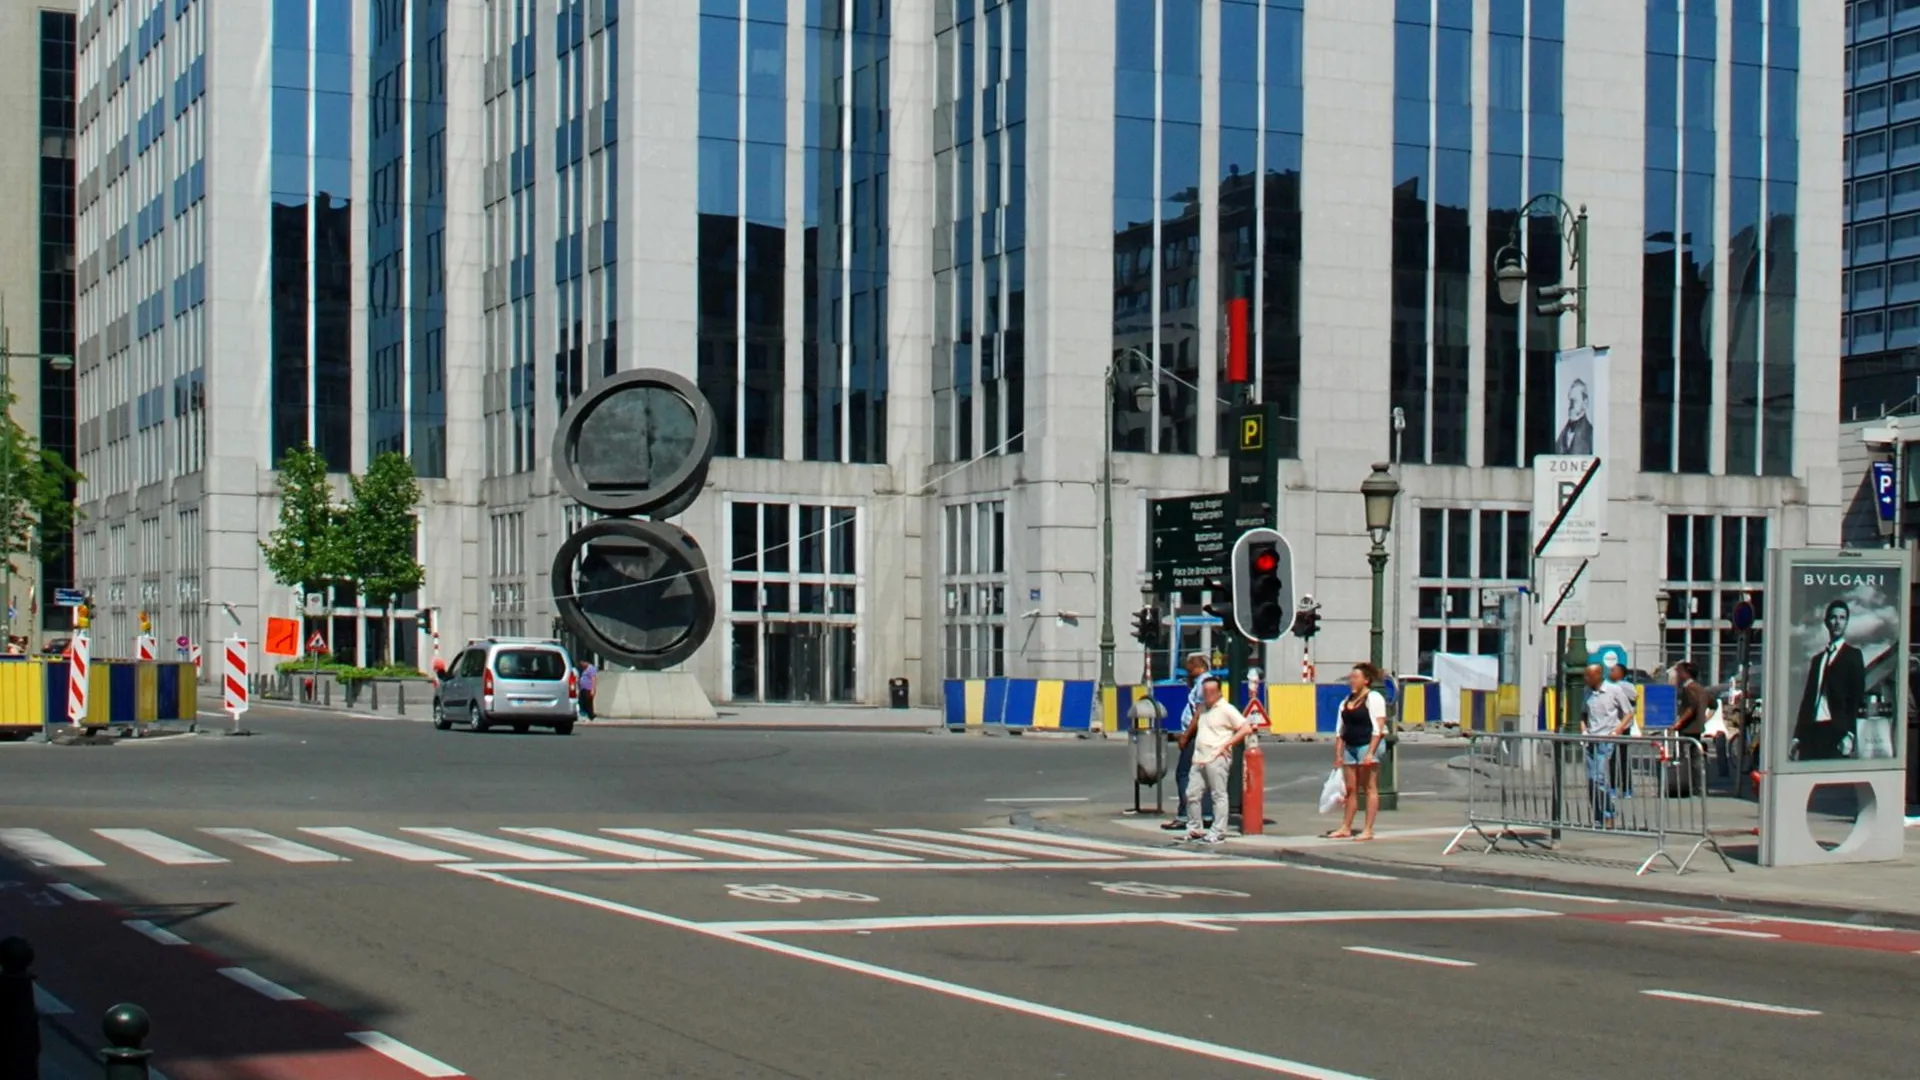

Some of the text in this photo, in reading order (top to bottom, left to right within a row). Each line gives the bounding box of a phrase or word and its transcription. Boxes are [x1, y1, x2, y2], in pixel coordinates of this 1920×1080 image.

[1244, 420, 1258, 445] P
[1550, 460, 1589, 472] ZONE
[1880, 475, 1892, 494] P
[1804, 573, 1885, 586] BVLGARI
